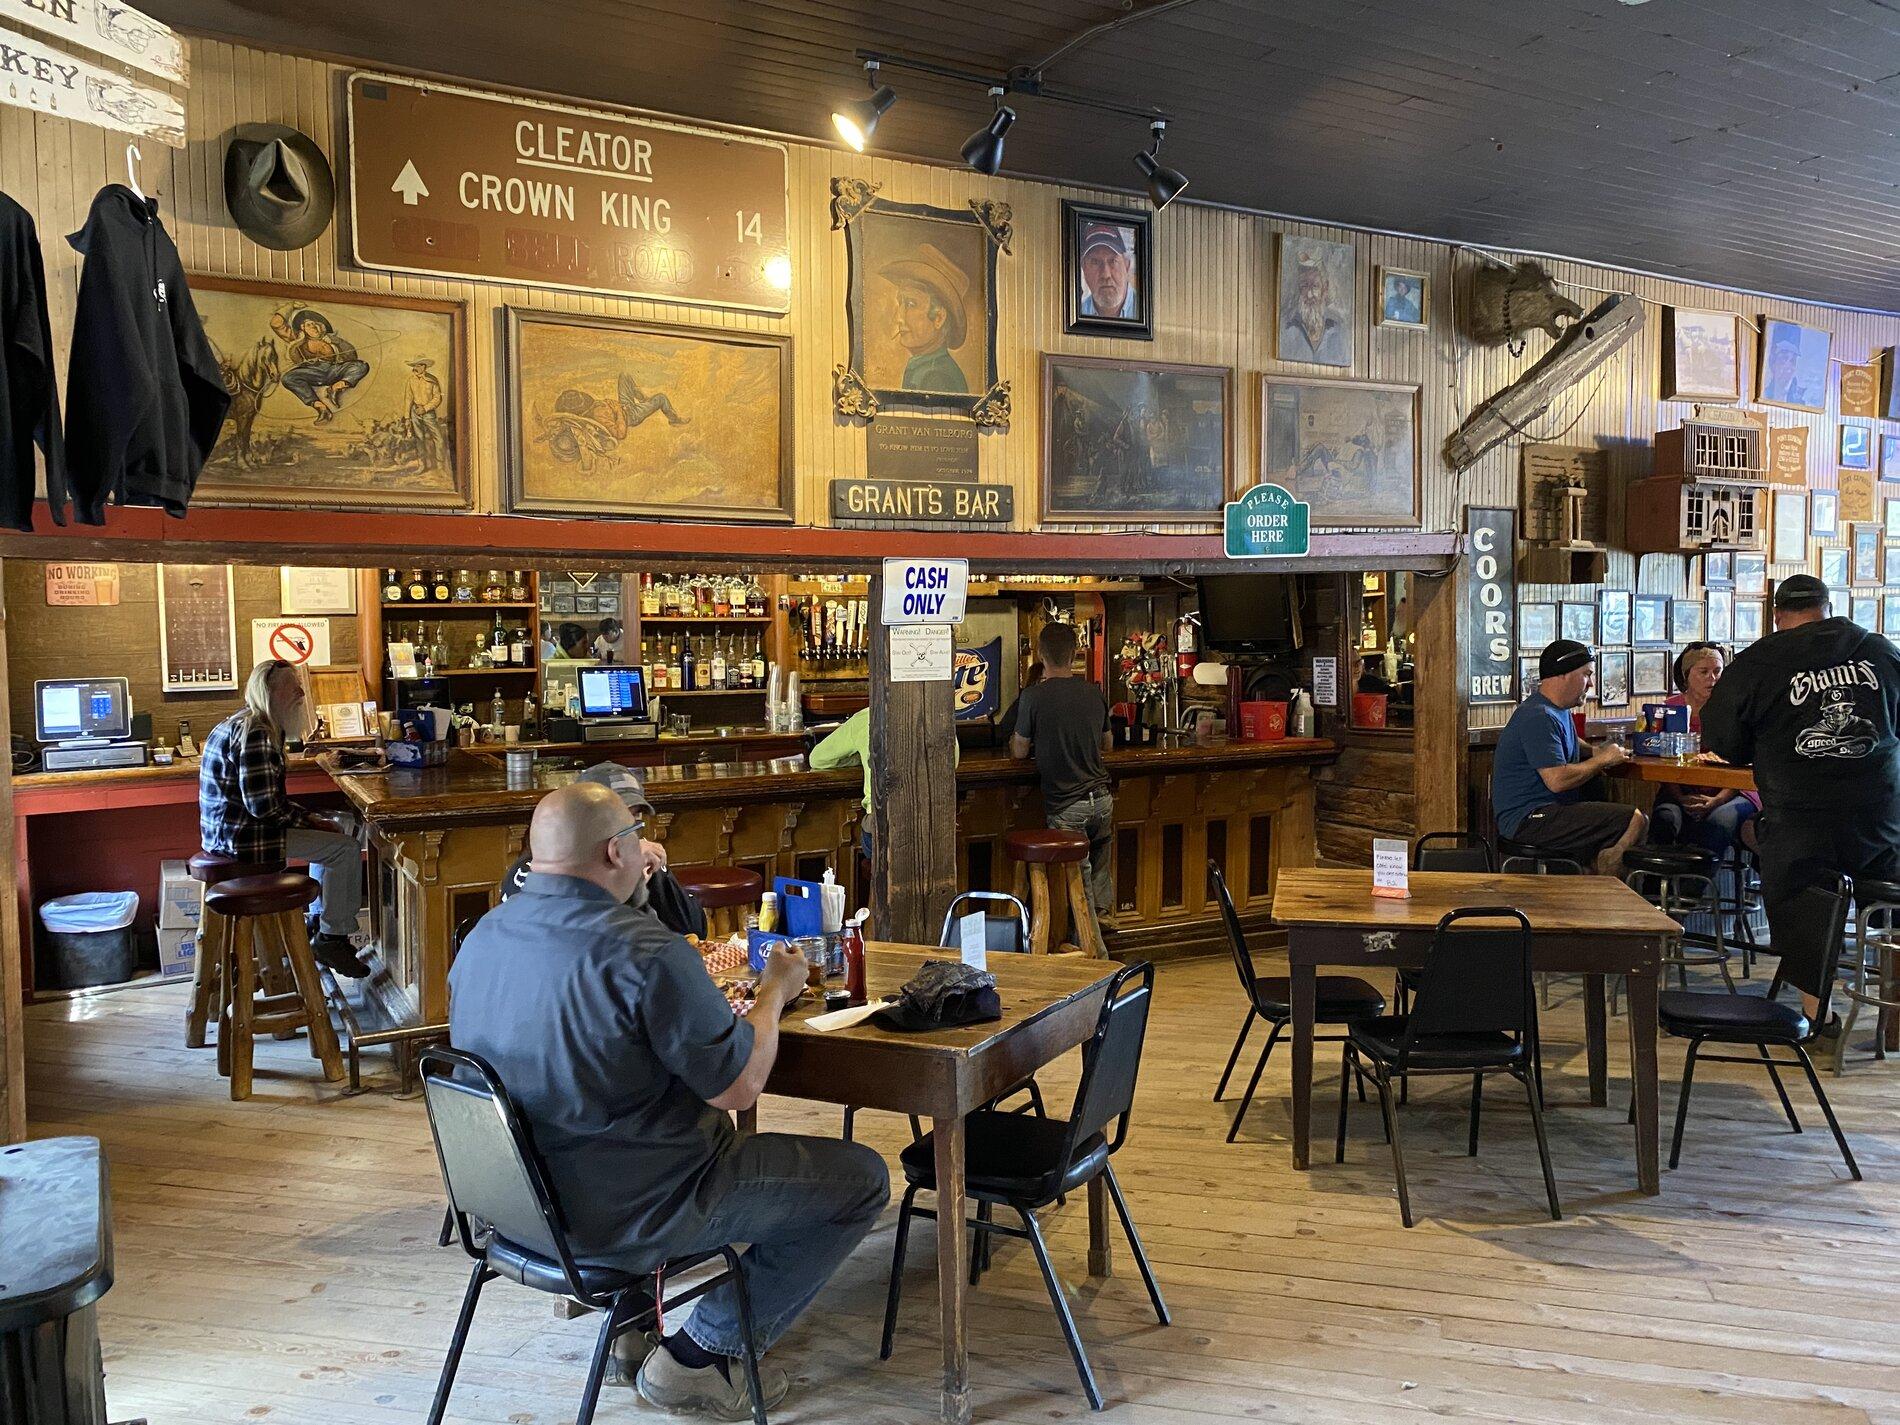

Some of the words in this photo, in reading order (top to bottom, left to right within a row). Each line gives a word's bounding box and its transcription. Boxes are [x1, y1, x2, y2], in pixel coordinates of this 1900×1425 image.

[515, 120, 653, 175] CLEATOR
[459, 171, 575, 222] CROWN
[601, 192, 672, 235] KING
[736, 210, 763, 246] 14
[614, 241, 695, 286] ROAD
[875, 424, 908, 435] GRANT
[911, 427, 930, 437] VAN
[848, 484, 942, 515] GRANT'S
[956, 489, 999, 517] BAR
[1247, 492, 1289, 510] PLEASE
[1247, 514, 1288, 528] ORDER
[1251, 530, 1284, 543] HERE
[48, 567, 63, 580] NO
[66, 565, 117, 581] WORKING
[905, 566, 949, 590] CASH
[903, 593, 946, 615] ONLY
[1473, 527, 1510, 662] COORS
[954, 654, 977, 665] iller
[954, 661, 989, 690] te
[1472, 674, 1512, 696] BREW
[1790, 659, 1879, 706] Glamis
